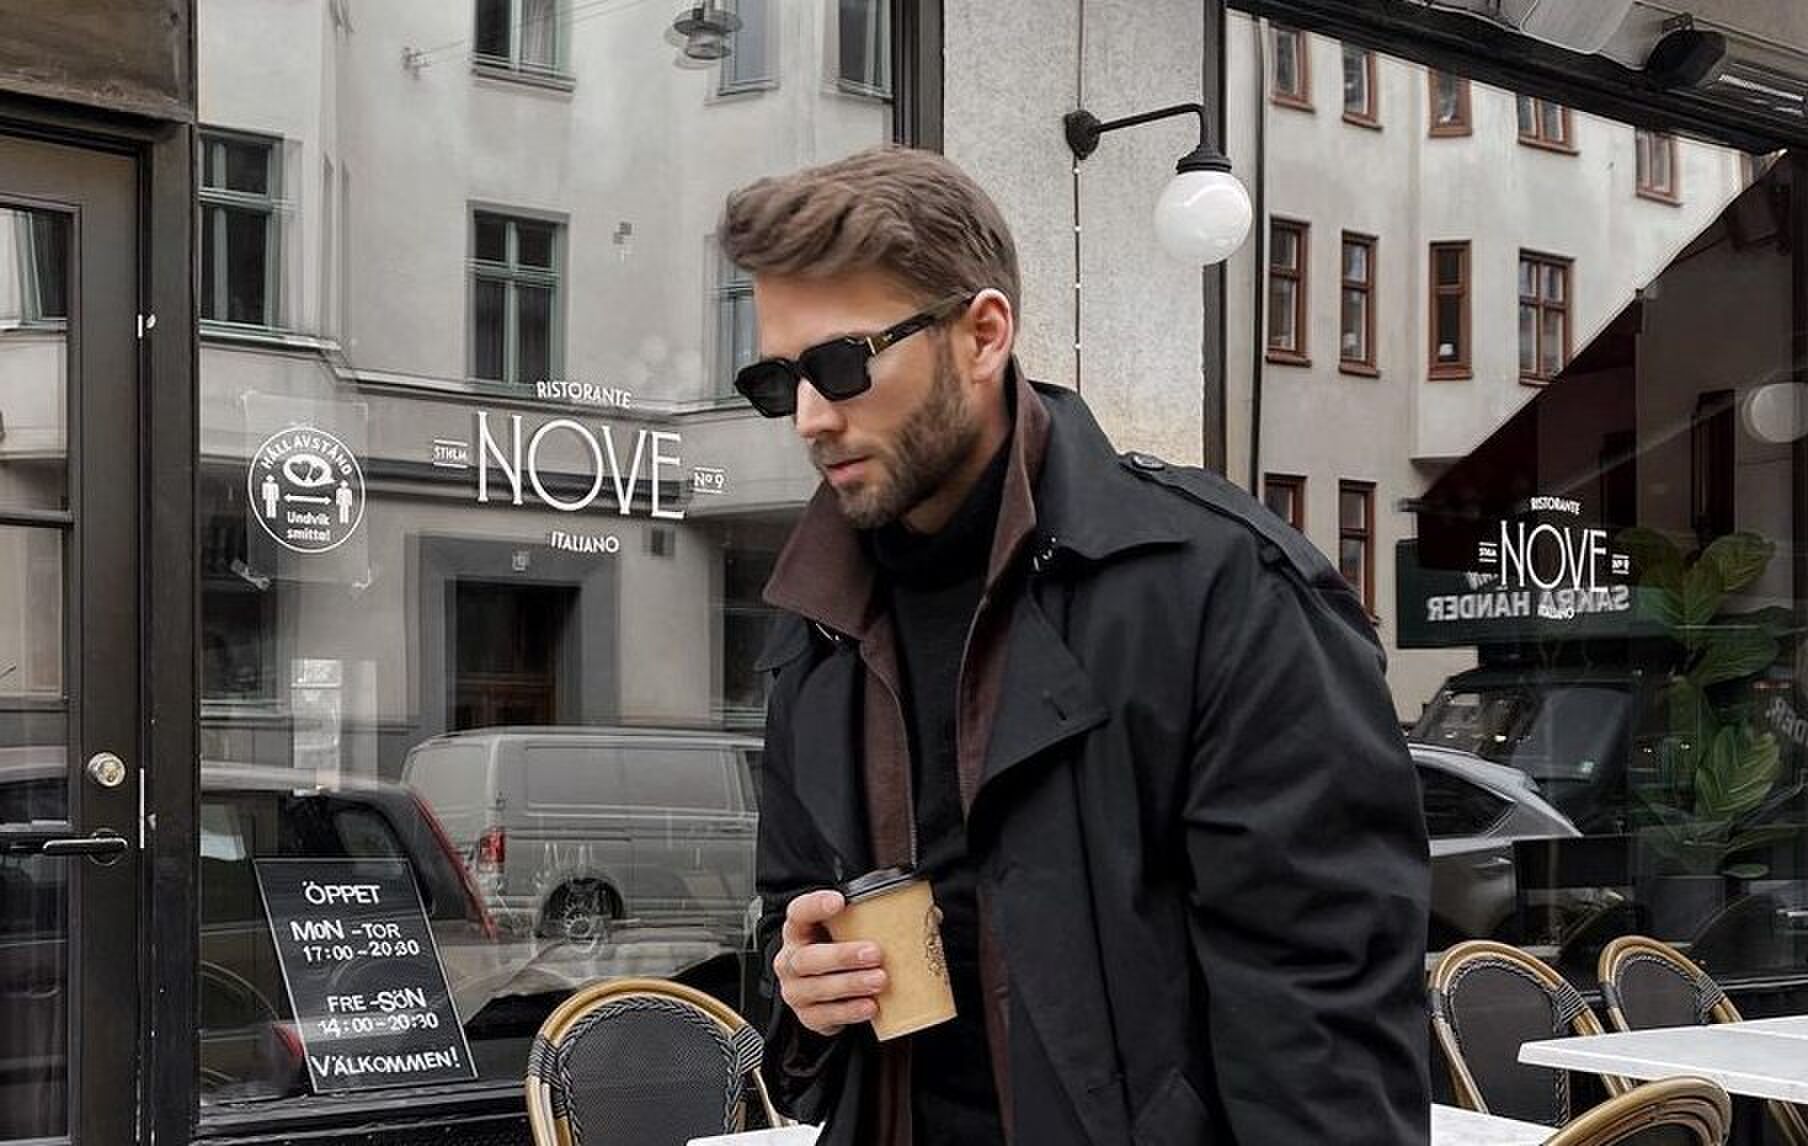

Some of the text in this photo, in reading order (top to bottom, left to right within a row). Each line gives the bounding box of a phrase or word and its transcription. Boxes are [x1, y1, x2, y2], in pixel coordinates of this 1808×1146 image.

[536, 381, 633, 409] RISTORANTE
[477, 410, 686, 519] NOVE
[287, 511, 331, 526] Undvik
[551, 531, 620, 554] ITALIANO
[1500, 519, 1609, 593] NOVE
[302, 881, 381, 905] ÖPPET
[310, 1046, 460, 1078] VÄLKOMMEN!
